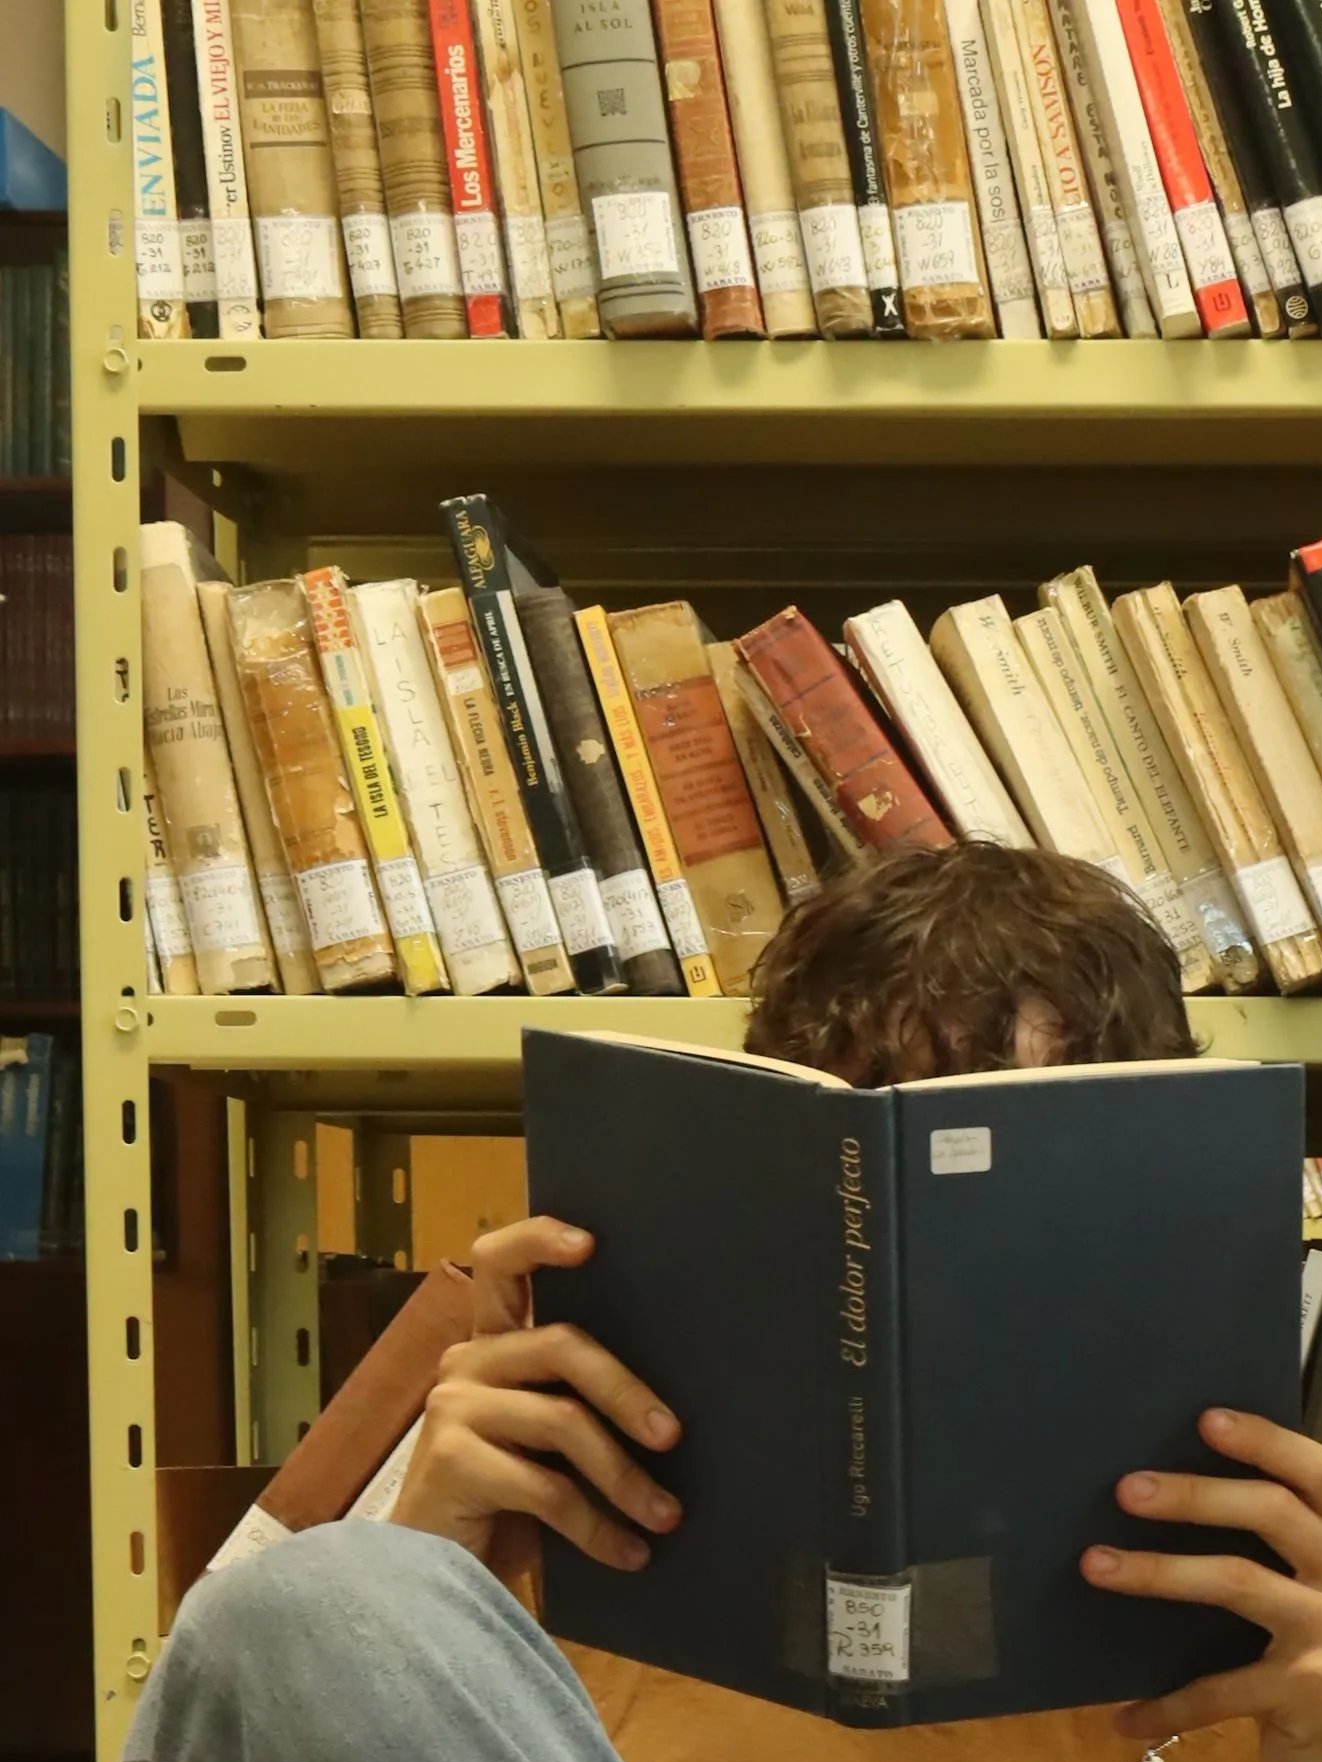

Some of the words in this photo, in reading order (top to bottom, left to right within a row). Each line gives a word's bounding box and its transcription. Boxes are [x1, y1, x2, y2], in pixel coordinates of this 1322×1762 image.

[205, 28, 224, 43] Y
[574, 21, 594, 33] AL
[600, 18, 633, 29] SOL
[1259, 34, 1277, 57] de
[208, 44, 229, 96] VIEJO
[961, 38, 988, 122] Marcada
[1266, 59, 1287, 90] hija
[214, 98, 231, 122] EL
[444, 44, 478, 169] Mercenarios
[850, 70, 869, 126] Canterville
[1277, 90, 1293, 110] La
[131, 55, 167, 217] ENVIADA
[858, 126, 871, 143] de
[972, 124, 994, 155] por
[218, 125, 237, 184] Ustinov
[859, 144, 878, 192] fantasma
[984, 156, 1001, 181] la
[461, 170, 483, 208] Los
[455, 508, 488, 590] ALFAGUARA
[493, 637, 503, 654] DE
[1036, 616, 1060, 655] morir
[463, 696, 475, 713] LA
[505, 684, 515, 698] EN
[1060, 671, 1085, 712] tiempo
[506, 702, 524, 734] Black
[1072, 575, 1102, 631] WILBUR
[1096, 631, 1119, 677] SMITH
[1121, 700, 1150, 760] CANTO
[1154, 785, 1191, 853] ELEFANTE
[351, 725, 374, 763] TESORO
[512, 733, 540, 789] Benjamin
[363, 761, 380, 780] DEL
[369, 779, 386, 804] ISLA
[1103, 770, 1131, 817] Tiempo
[375, 804, 389, 819] LA
[646, 823, 670, 864] AMIGOS,
[1128, 823, 1157, 876] Barnard
[834, 1135, 873, 1250] perfecto
[837, 1251, 868, 1333] dolor
[840, 1337, 869, 1368] El
[847, 1394, 866, 1481] Riccarelli
[849, 1483, 872, 1518] Ugo
[844, 1599, 886, 1617] 850
